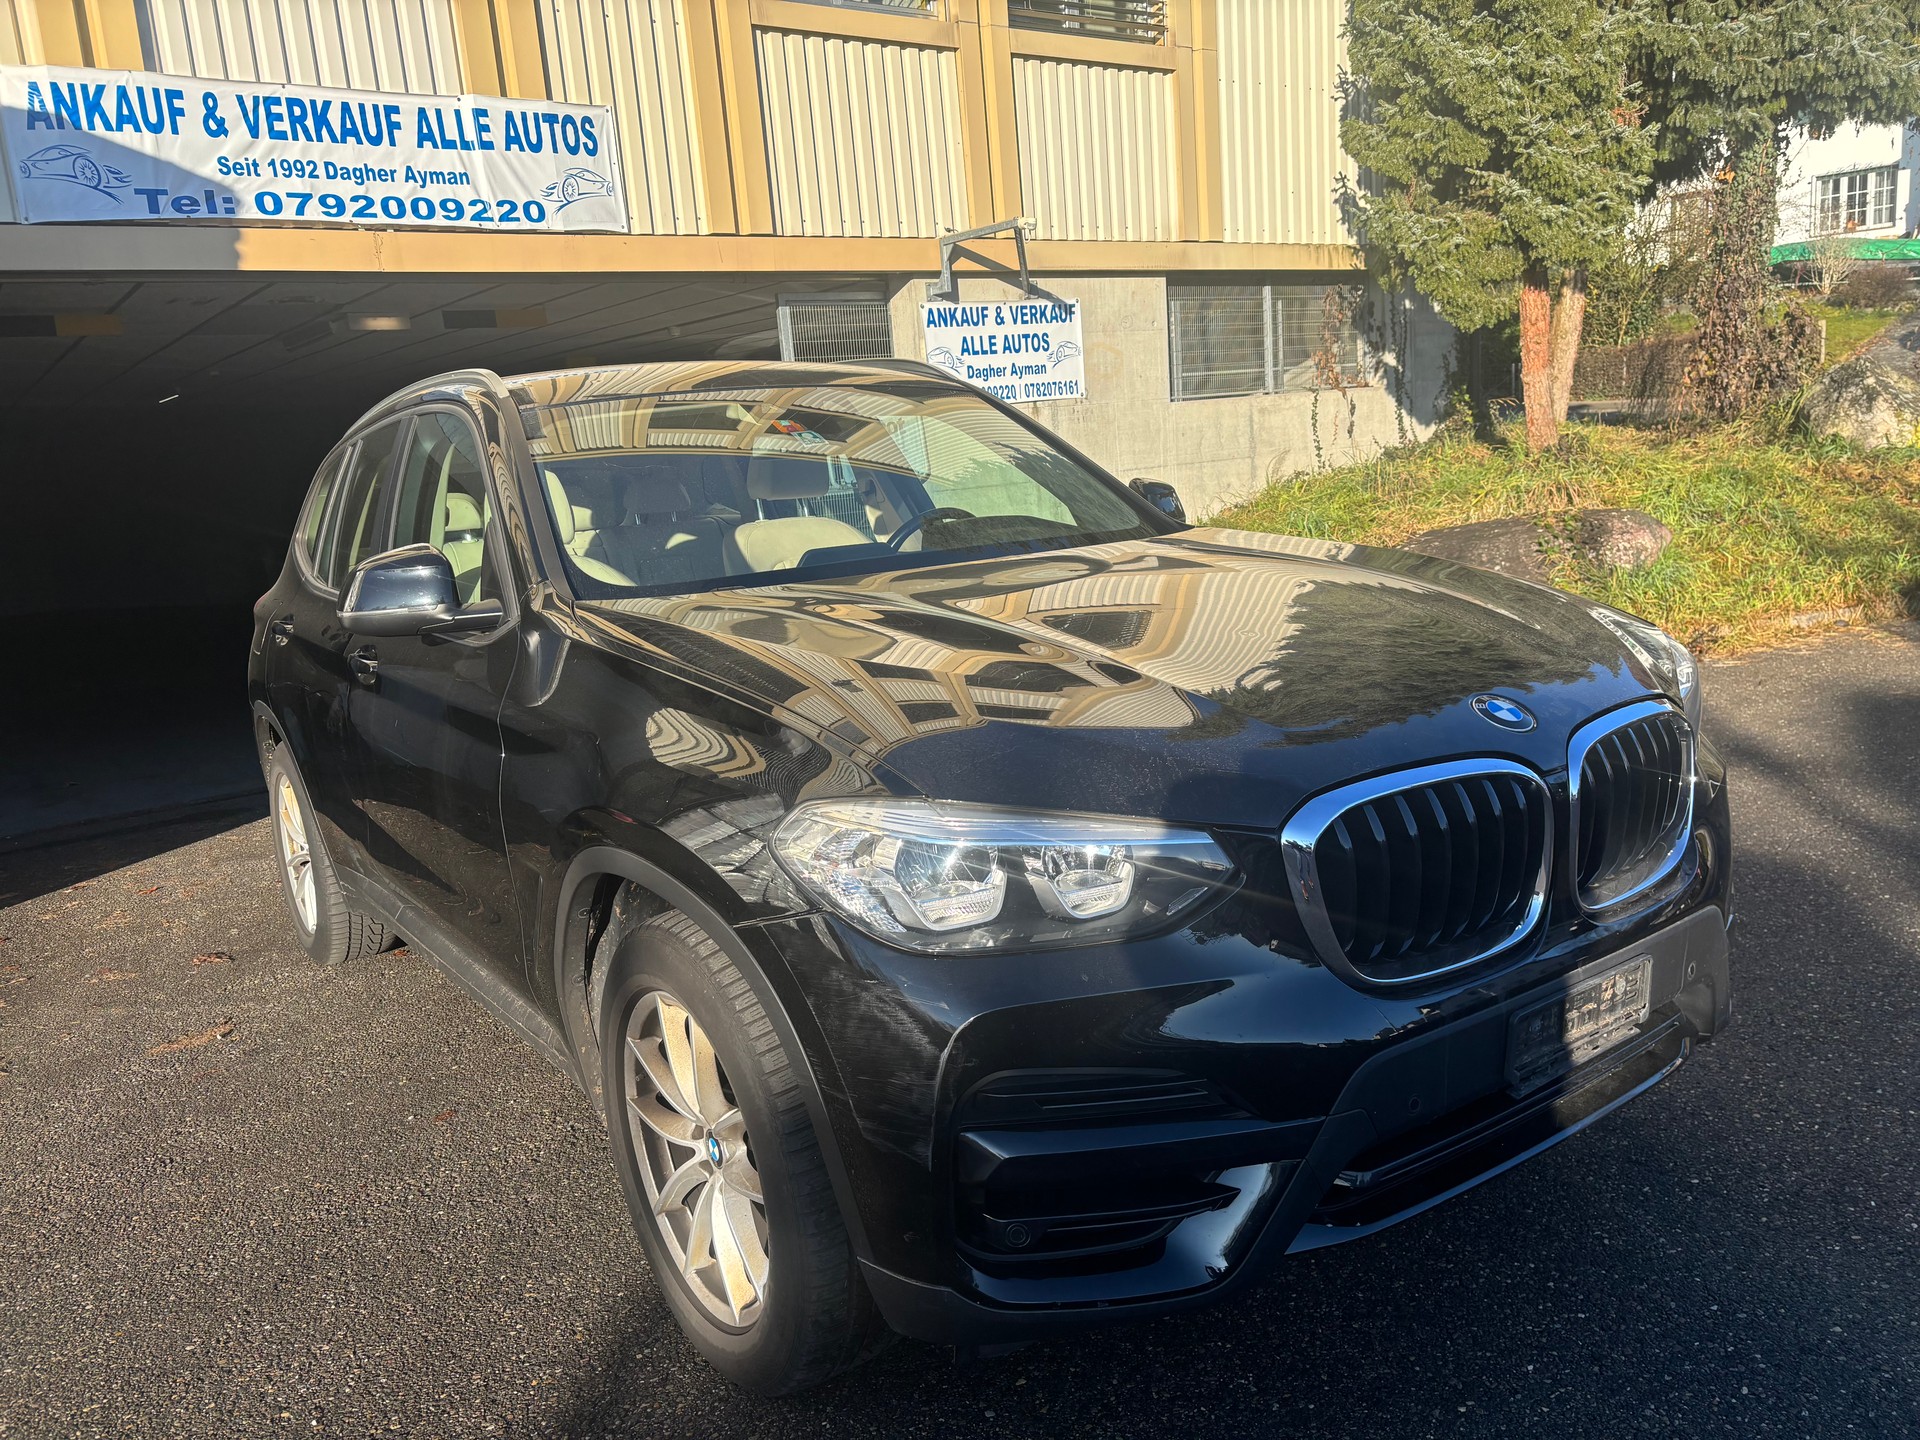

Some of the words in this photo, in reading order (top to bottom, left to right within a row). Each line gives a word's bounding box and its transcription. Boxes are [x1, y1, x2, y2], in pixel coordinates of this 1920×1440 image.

[26, 81, 185, 135] ANKAUF
[202, 91, 229, 138] &
[235, 94, 402, 147] VERKAUF
[417, 107, 495, 151] ALLE
[505, 111, 599, 157] AUTOS
[217, 155, 261, 177] Seit
[267, 158, 318, 180] 1992
[324, 161, 397, 186] Dagher
[404, 165, 471, 188] Ayman
[134, 188, 237, 215] Tel:
[254, 191, 546, 223] 0792009220
[926, 306, 989, 328] ANKAUF
[995, 306, 1006, 326] &
[1009, 304, 1076, 325] VERKAUF
[961, 335, 998, 356] ALLE
[1002, 332, 1050, 354] AUTOS
[967, 364, 1007, 381] Dagher
[1010, 362, 1047, 379] Ayman
[1024, 380, 1079, 398] 0782076161
